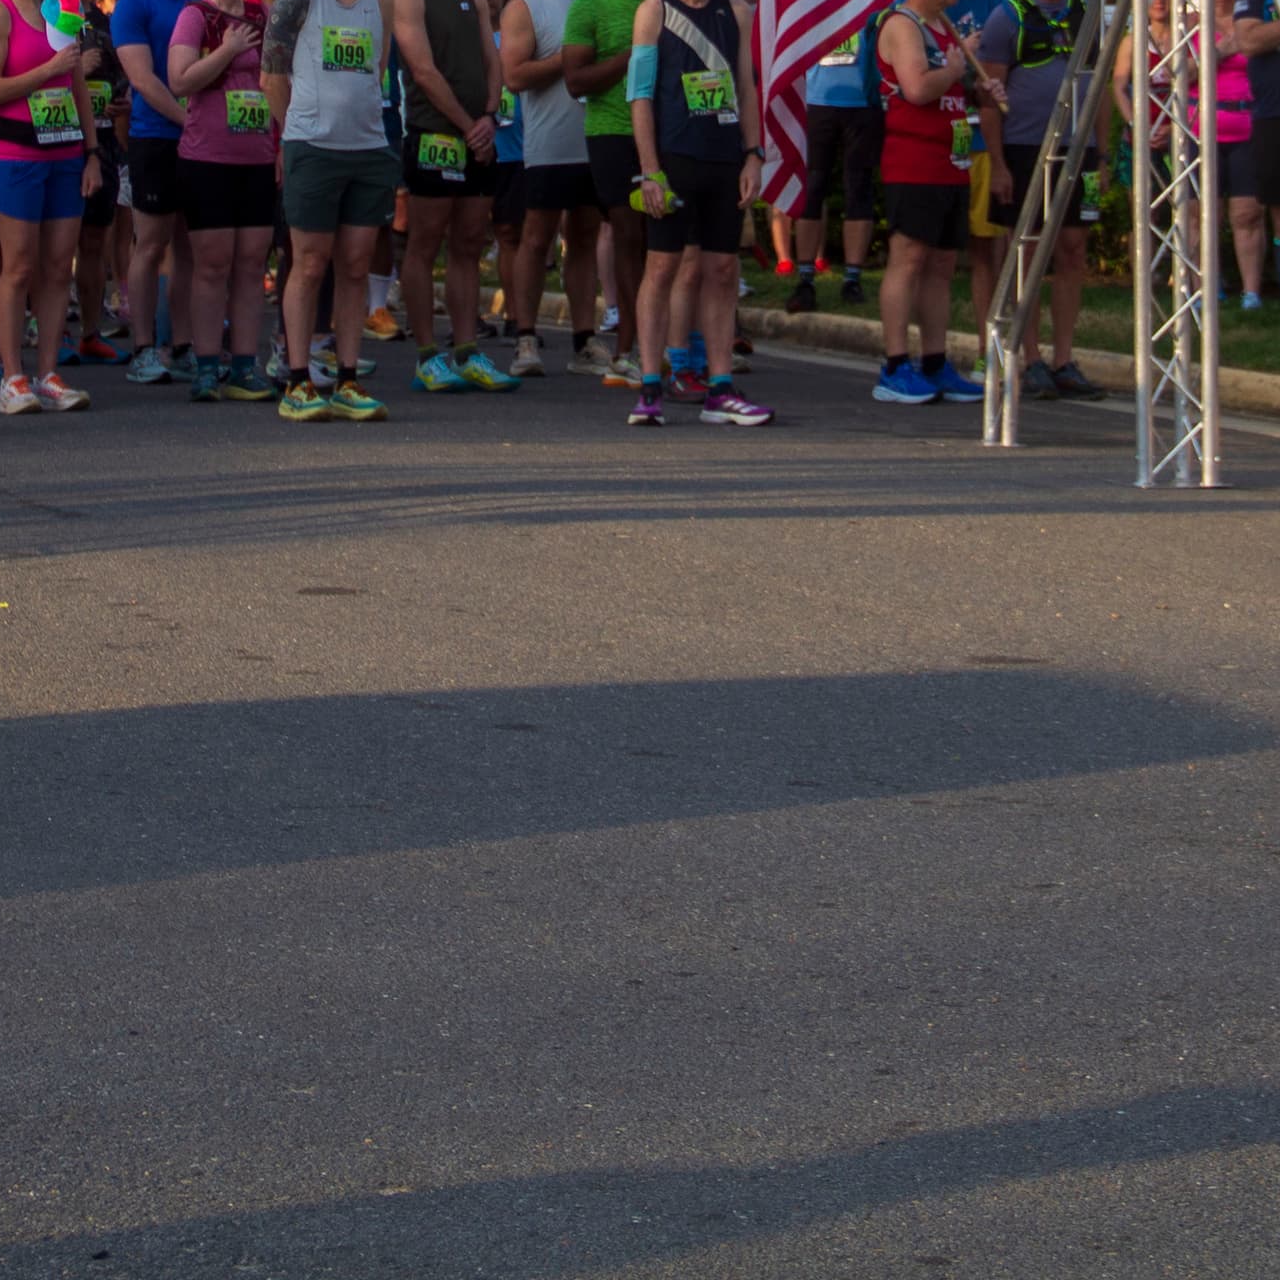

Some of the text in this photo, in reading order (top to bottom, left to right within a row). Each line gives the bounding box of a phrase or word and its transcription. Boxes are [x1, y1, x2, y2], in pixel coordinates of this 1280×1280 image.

[334, 44, 366, 66] 099
[696, 86, 728, 109] 372
[41, 105, 71, 125] 221
[237, 107, 265, 126] 249
[428, 144, 458, 166] 043
